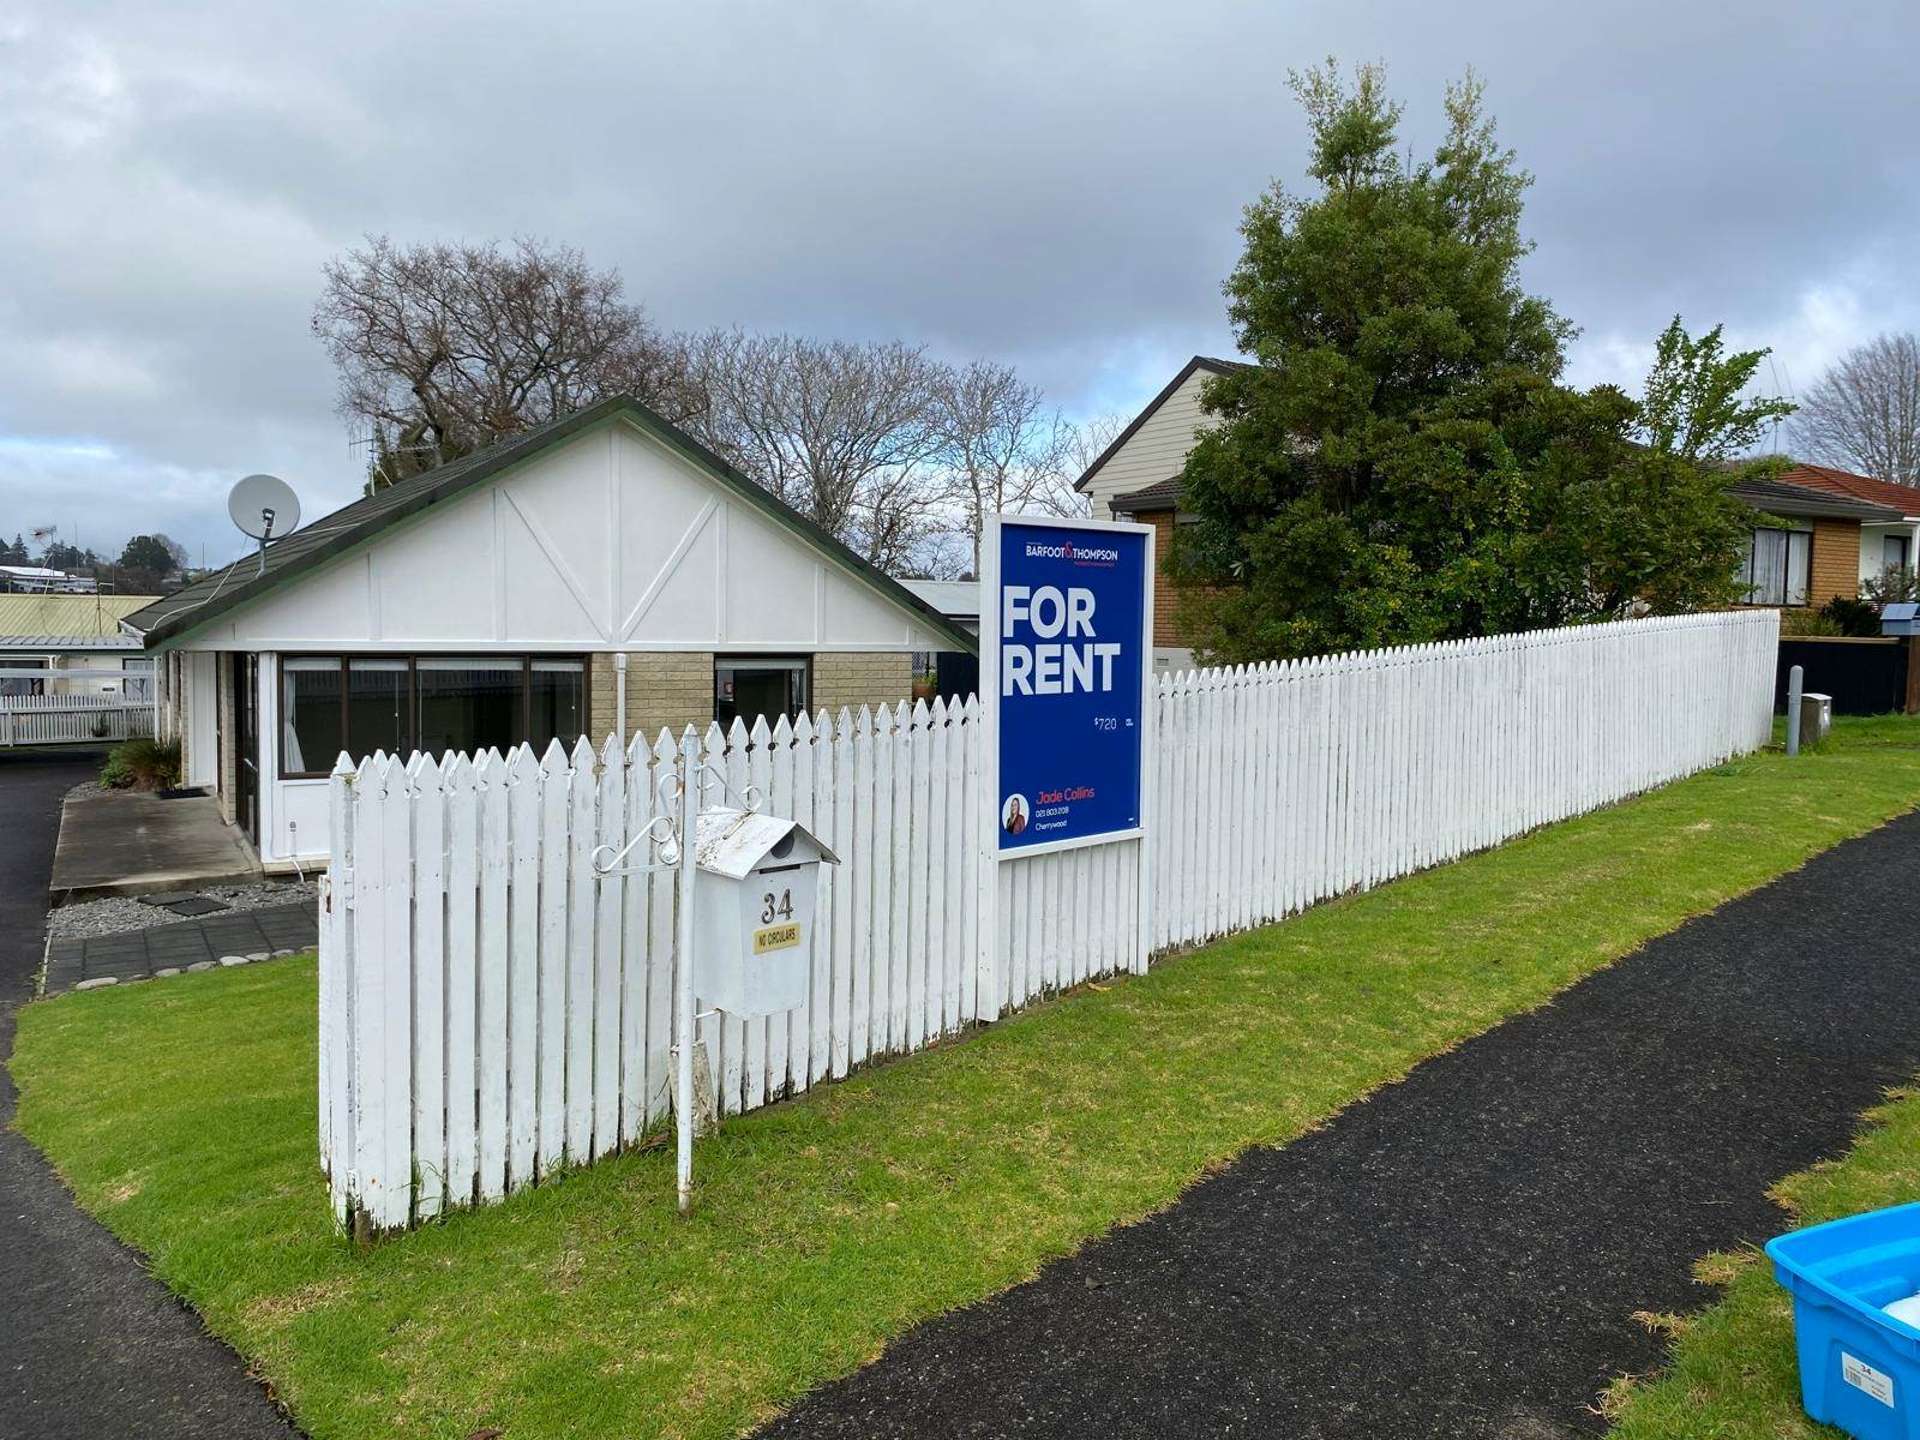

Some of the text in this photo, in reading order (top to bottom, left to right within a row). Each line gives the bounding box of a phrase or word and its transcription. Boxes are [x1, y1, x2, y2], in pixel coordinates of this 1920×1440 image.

[1002, 585, 1097, 639] FOR
[1002, 642, 1121, 697] RENT
[1094, 717, 1117, 730] $720
[1036, 786, 1096, 805] Jade Collins
[761, 888, 794, 925] 34
[759, 928, 796, 947] NO CIRCULARS
